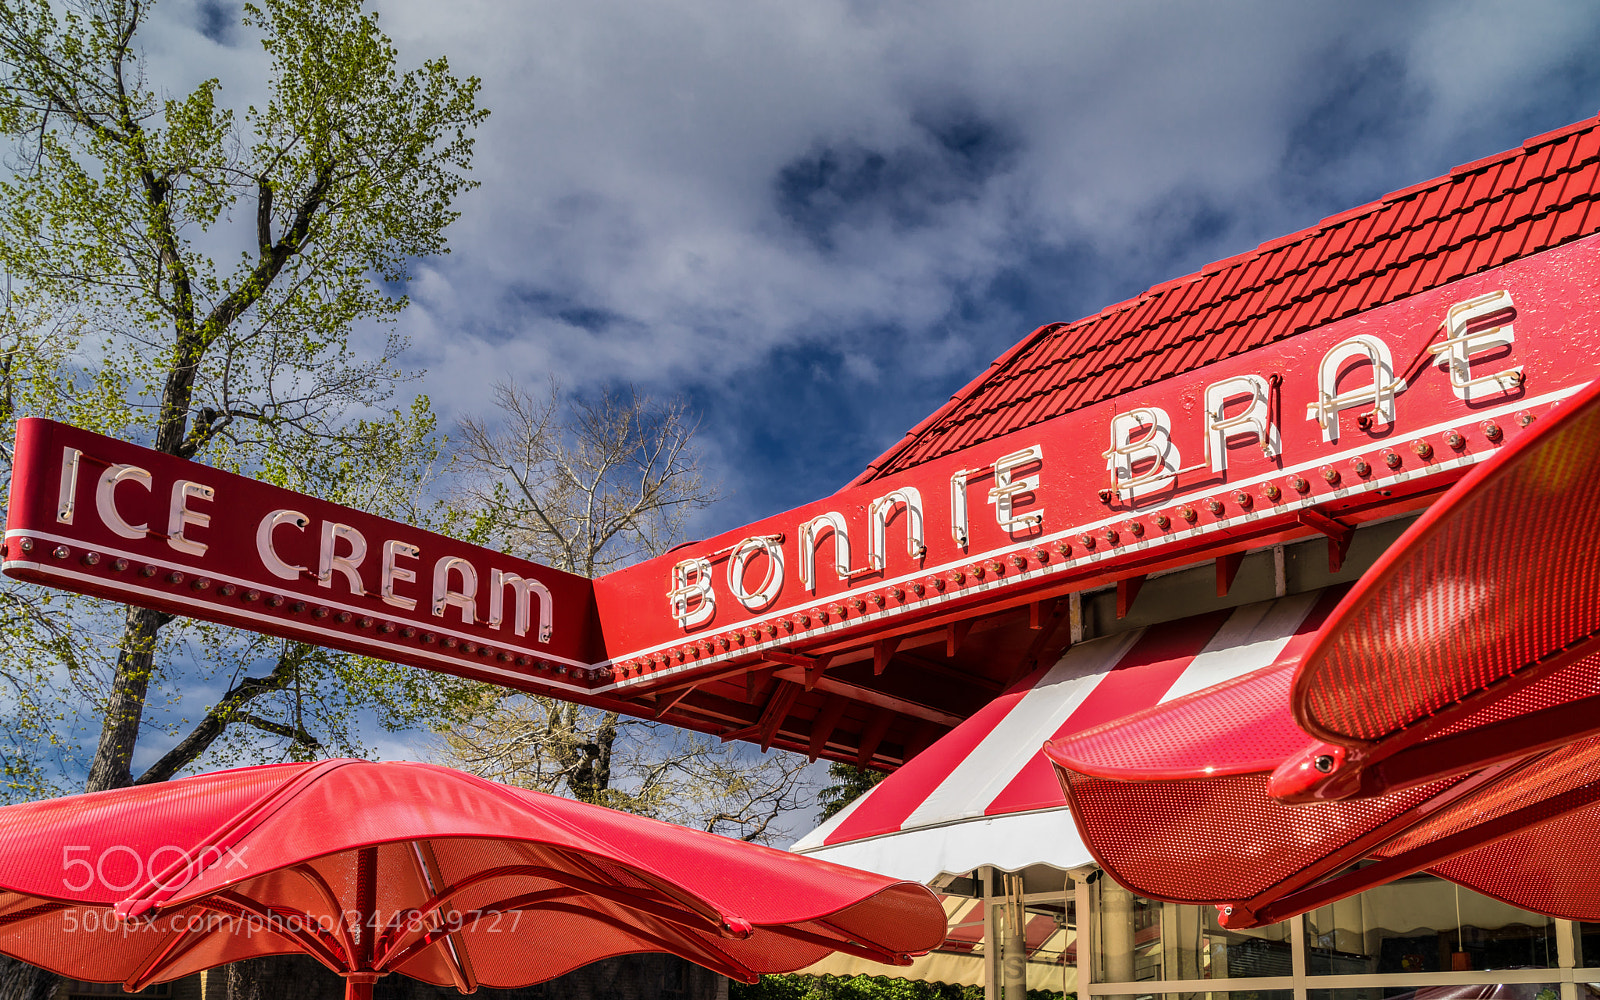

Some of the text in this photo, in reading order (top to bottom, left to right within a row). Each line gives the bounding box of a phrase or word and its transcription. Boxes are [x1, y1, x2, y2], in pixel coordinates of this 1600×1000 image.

[1102, 289, 1524, 500] BRAE
[56, 446, 553, 643] ICE CREAM
